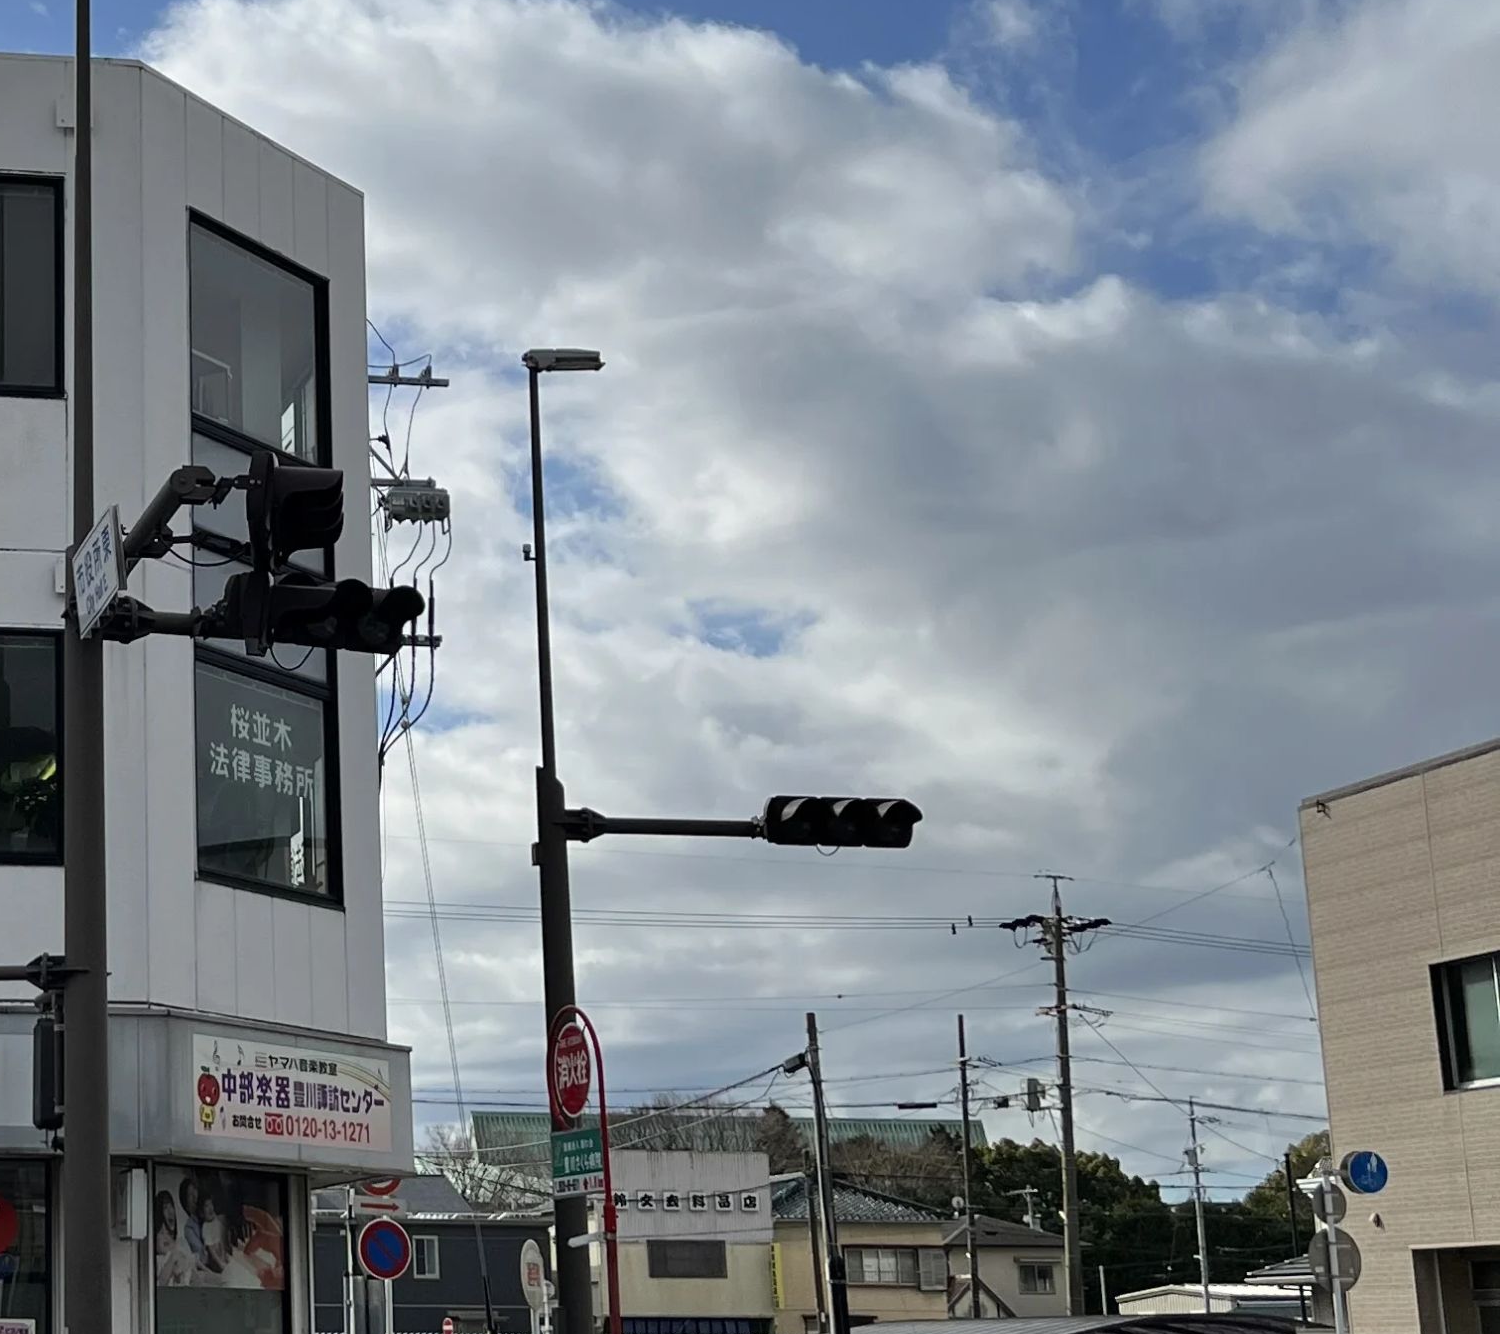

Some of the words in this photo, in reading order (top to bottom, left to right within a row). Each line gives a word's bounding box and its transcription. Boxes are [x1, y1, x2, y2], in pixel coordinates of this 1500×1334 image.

[230, 703, 293, 752] 桜並木
[209, 741, 314, 798] 法律事務所
[557, 1049, 588, 1091] 消火栓
[286, 1116, 370, 1144] 0120-13-1271
